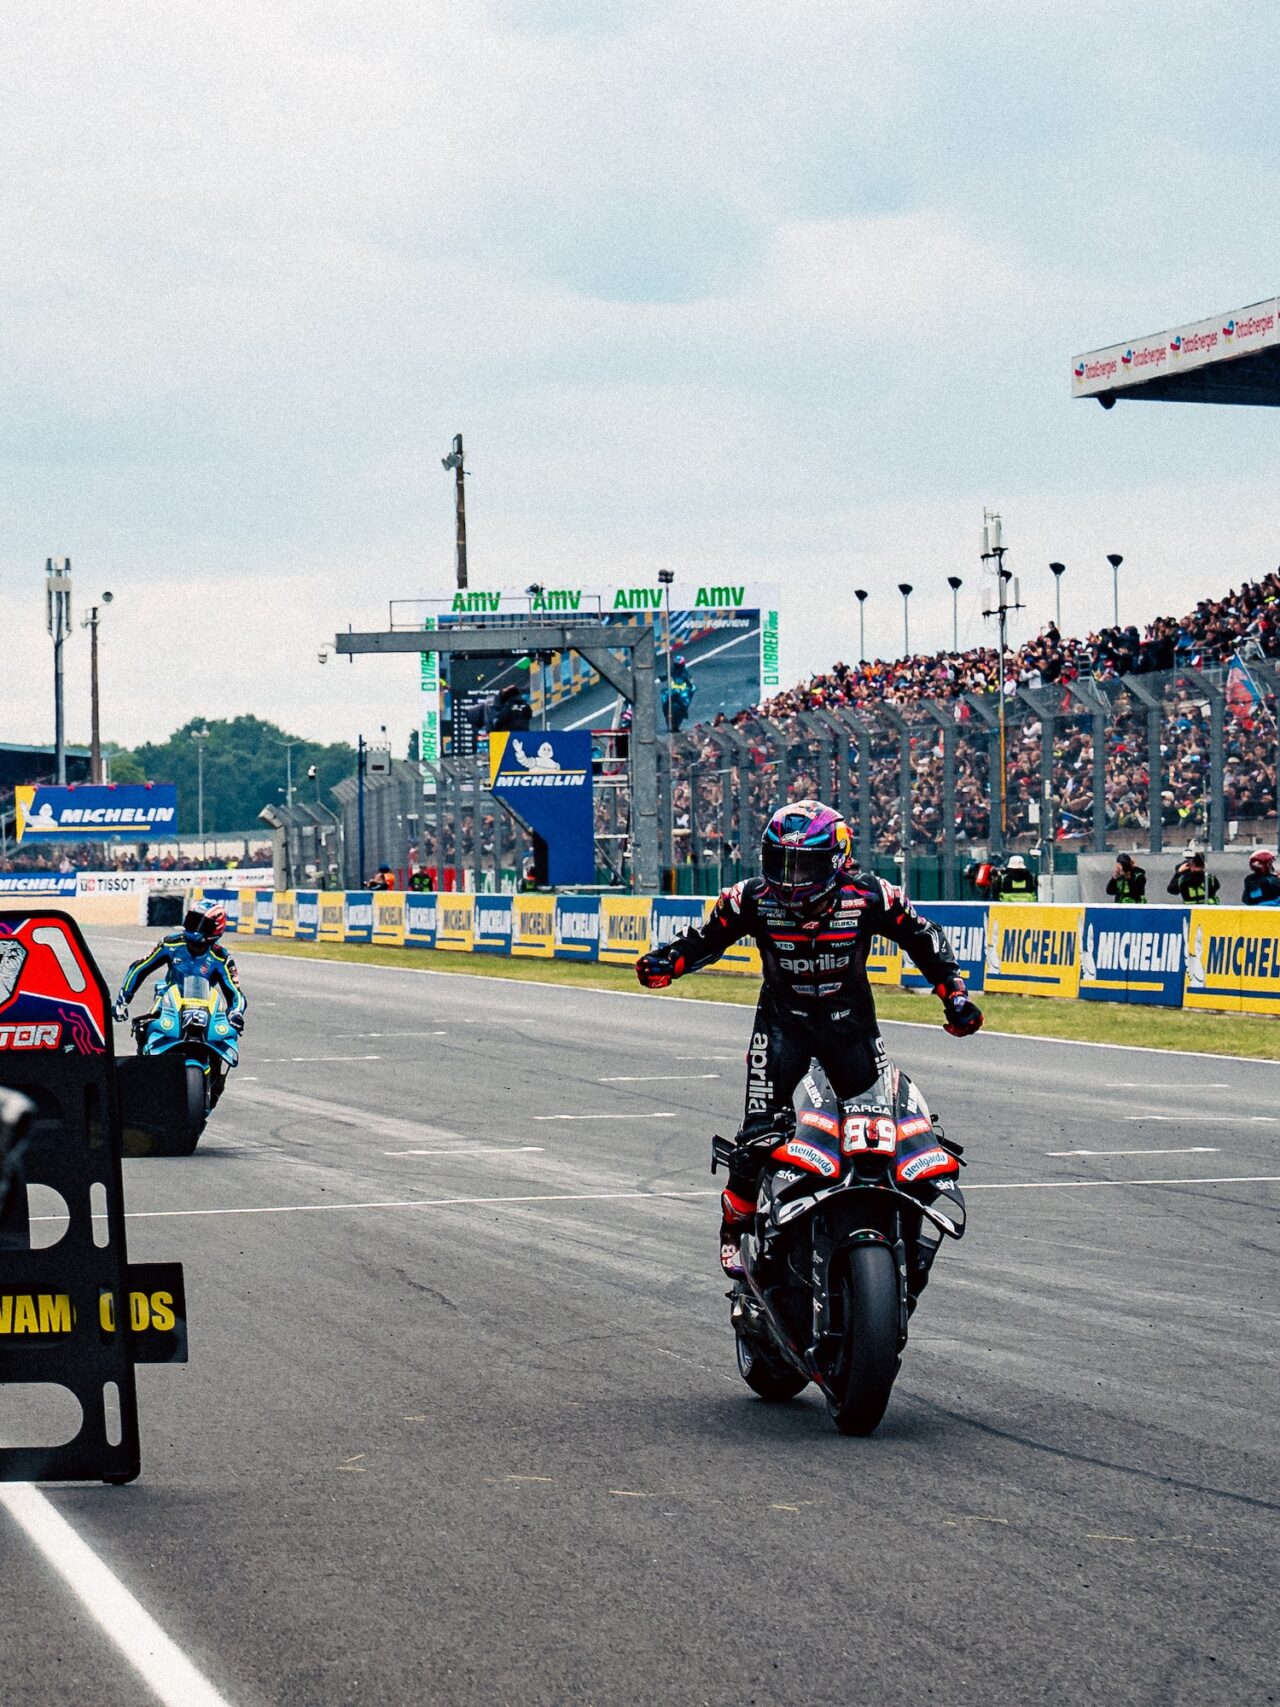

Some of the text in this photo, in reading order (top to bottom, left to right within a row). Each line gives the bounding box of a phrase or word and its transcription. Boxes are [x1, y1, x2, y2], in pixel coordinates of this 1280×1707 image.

[496, 775, 585, 787] MICHELIN
[59, 807, 175, 824] MICHELIN
[97, 878, 136, 892] TISSOT
[608, 915, 647, 941] MICHELIN
[1002, 928, 1077, 966] MICHELIN
[1096, 931, 1183, 973] MICHELIN
[1207, 936, 1280, 978] MICHEL
[780, 954, 850, 974] aprilia
[748, 1032, 774, 1115] aprilia
[843, 1104, 892, 1116] TARGA
[842, 1117, 896, 1154] 89
[790, 1145, 833, 1174] sterilgarda
[904, 1152, 946, 1178] sterilgarda
[776, 1169, 801, 1182] sky
[935, 1179, 955, 1191] sky
